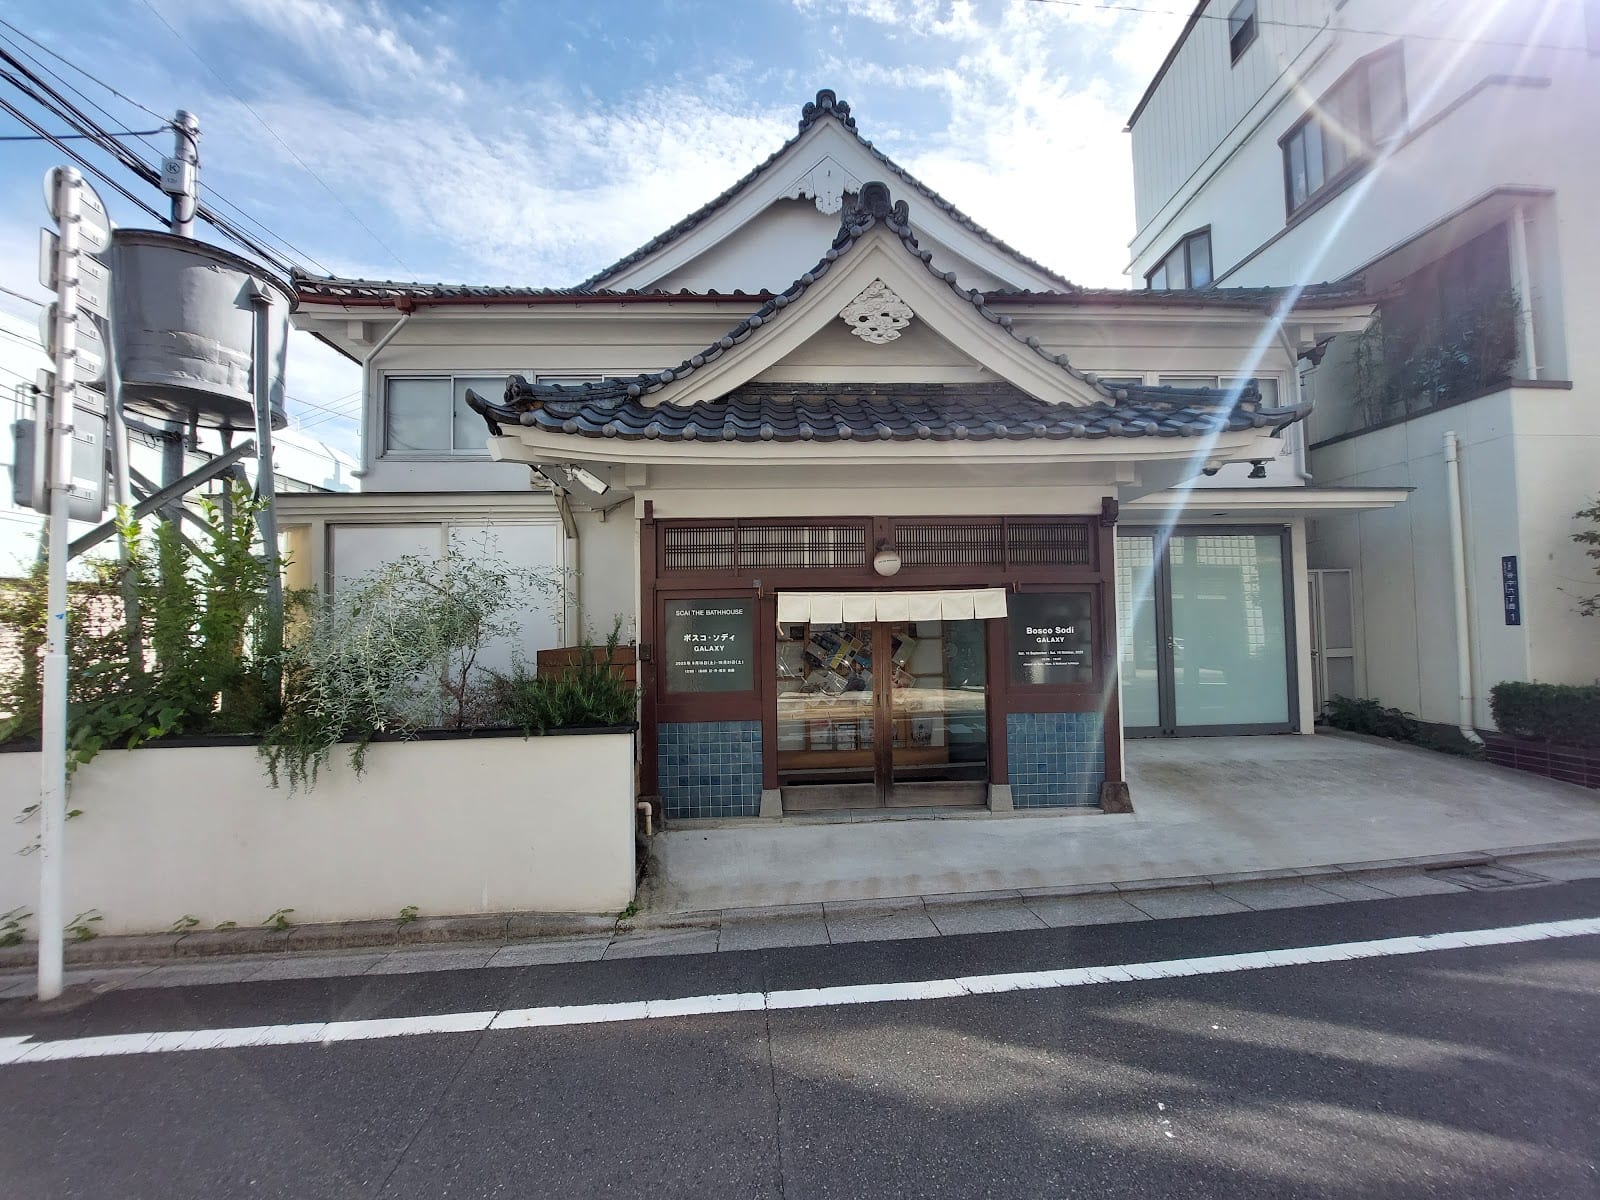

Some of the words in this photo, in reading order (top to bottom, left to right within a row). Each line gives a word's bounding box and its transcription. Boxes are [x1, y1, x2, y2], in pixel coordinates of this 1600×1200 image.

[705, 608, 744, 616] BATHHOUSE
[1026, 626, 1053, 635] Bosco
[1055, 626, 1074, 634] Sodi
[683, 633, 736, 642] ボスコ・ソディ
